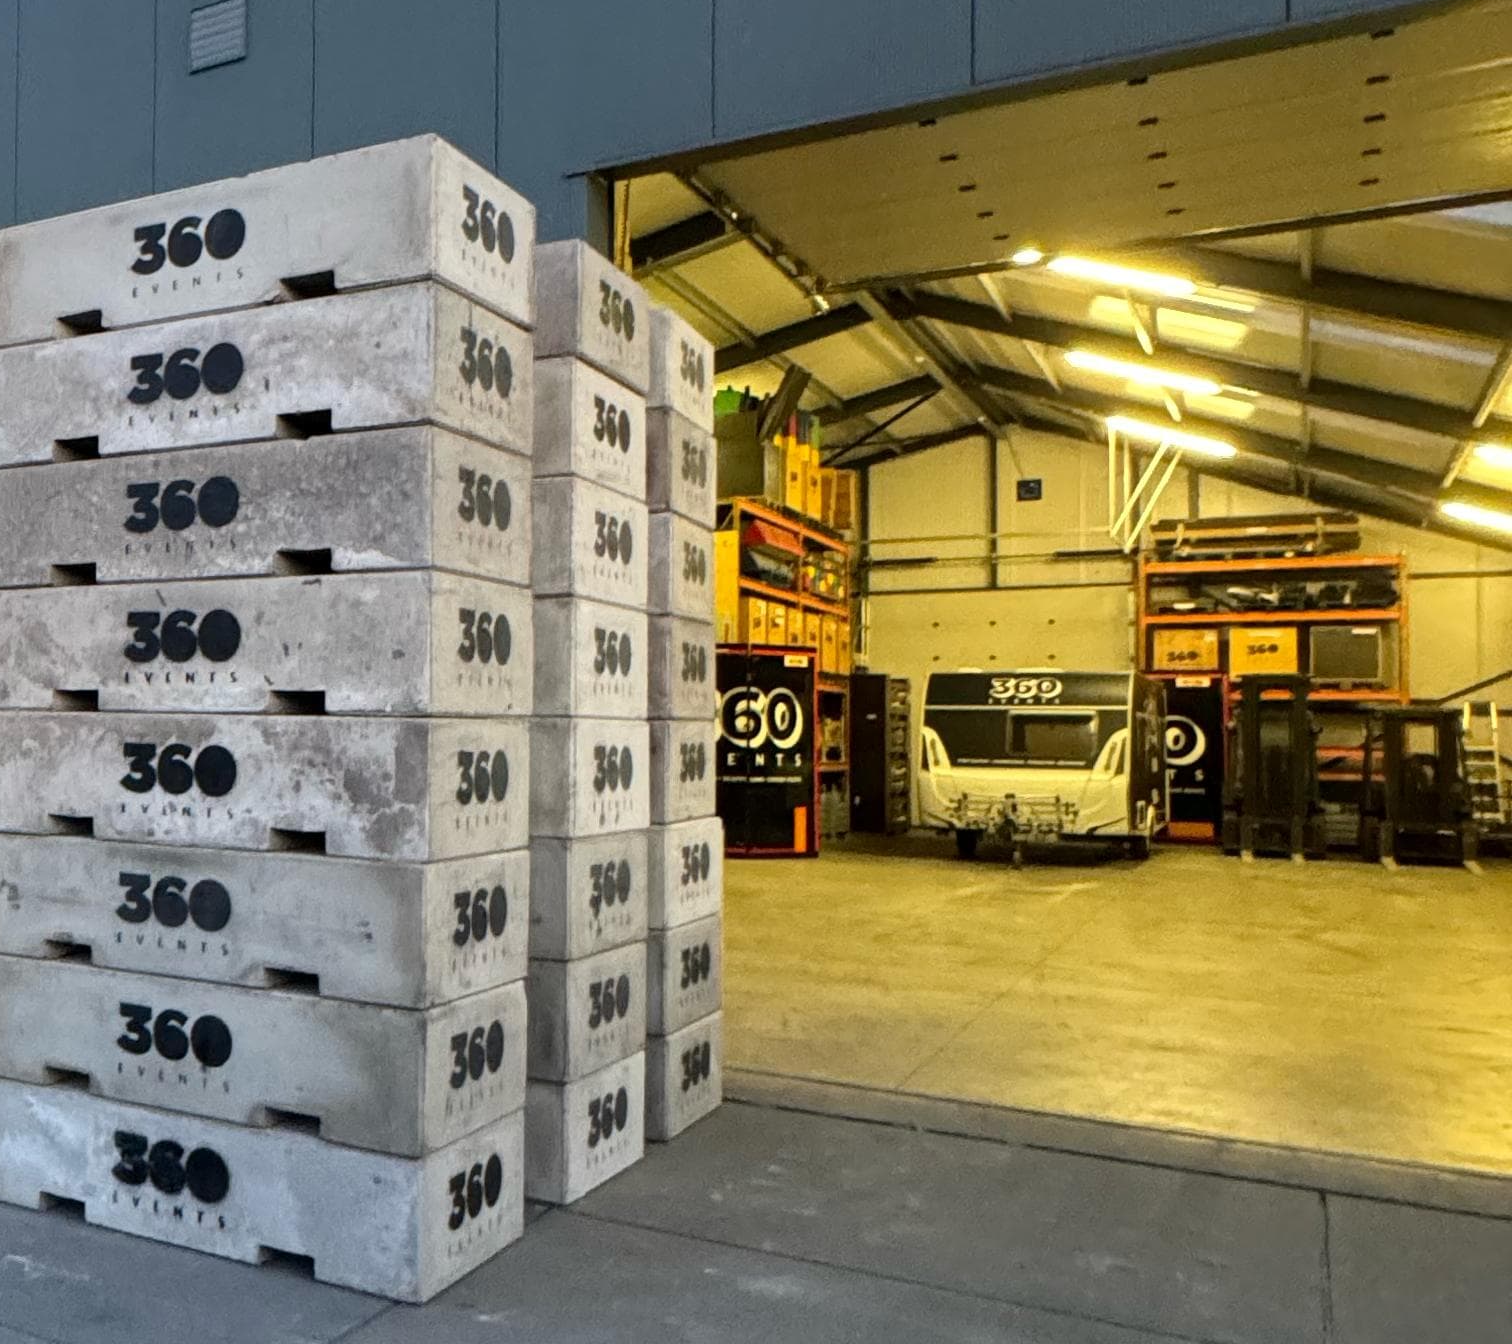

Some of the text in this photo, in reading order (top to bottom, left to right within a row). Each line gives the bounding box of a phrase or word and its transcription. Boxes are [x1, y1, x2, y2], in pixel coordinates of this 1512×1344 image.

[131, 208, 246, 275] 360
[462, 184, 514, 264] 360
[132, 268, 245, 297] EVENTS
[599, 279, 635, 342] 360
[128, 342, 244, 404] 360
[459, 326, 512, 399] 360
[128, 401, 240, 428] EVENTS
[594, 394, 630, 453] 360
[125, 476, 240, 533] 360
[458, 464, 511, 531] 360
[125, 536, 237, 555] EVENTS
[595, 511, 632, 565] 360
[125, 609, 241, 664] 360
[458, 608, 511, 665] 360
[594, 626, 632, 677] 360
[124, 671, 238, 684] EVENTS
[989, 677, 1063, 699] 360
[715, 686, 803, 749] 60
[121, 743, 237, 797] 360
[456, 749, 509, 805] 360
[593, 745, 633, 794] 360
[726, 753, 802, 767] ENTS
[120, 801, 234, 819] EVENTS
[115, 872, 231, 931] 360
[453, 885, 507, 947] 360
[589, 859, 630, 919] 360
[116, 932, 229, 955] EVENTS
[589, 974, 630, 1029] 360
[117, 1002, 232, 1067] 360
[449, 1019, 504, 1089] 360
[118, 1062, 230, 1093] EVENTS
[588, 1086, 628, 1148] 360
[113, 1193, 226, 1229] EVENTS
[448, 1153, 502, 1231] 360
